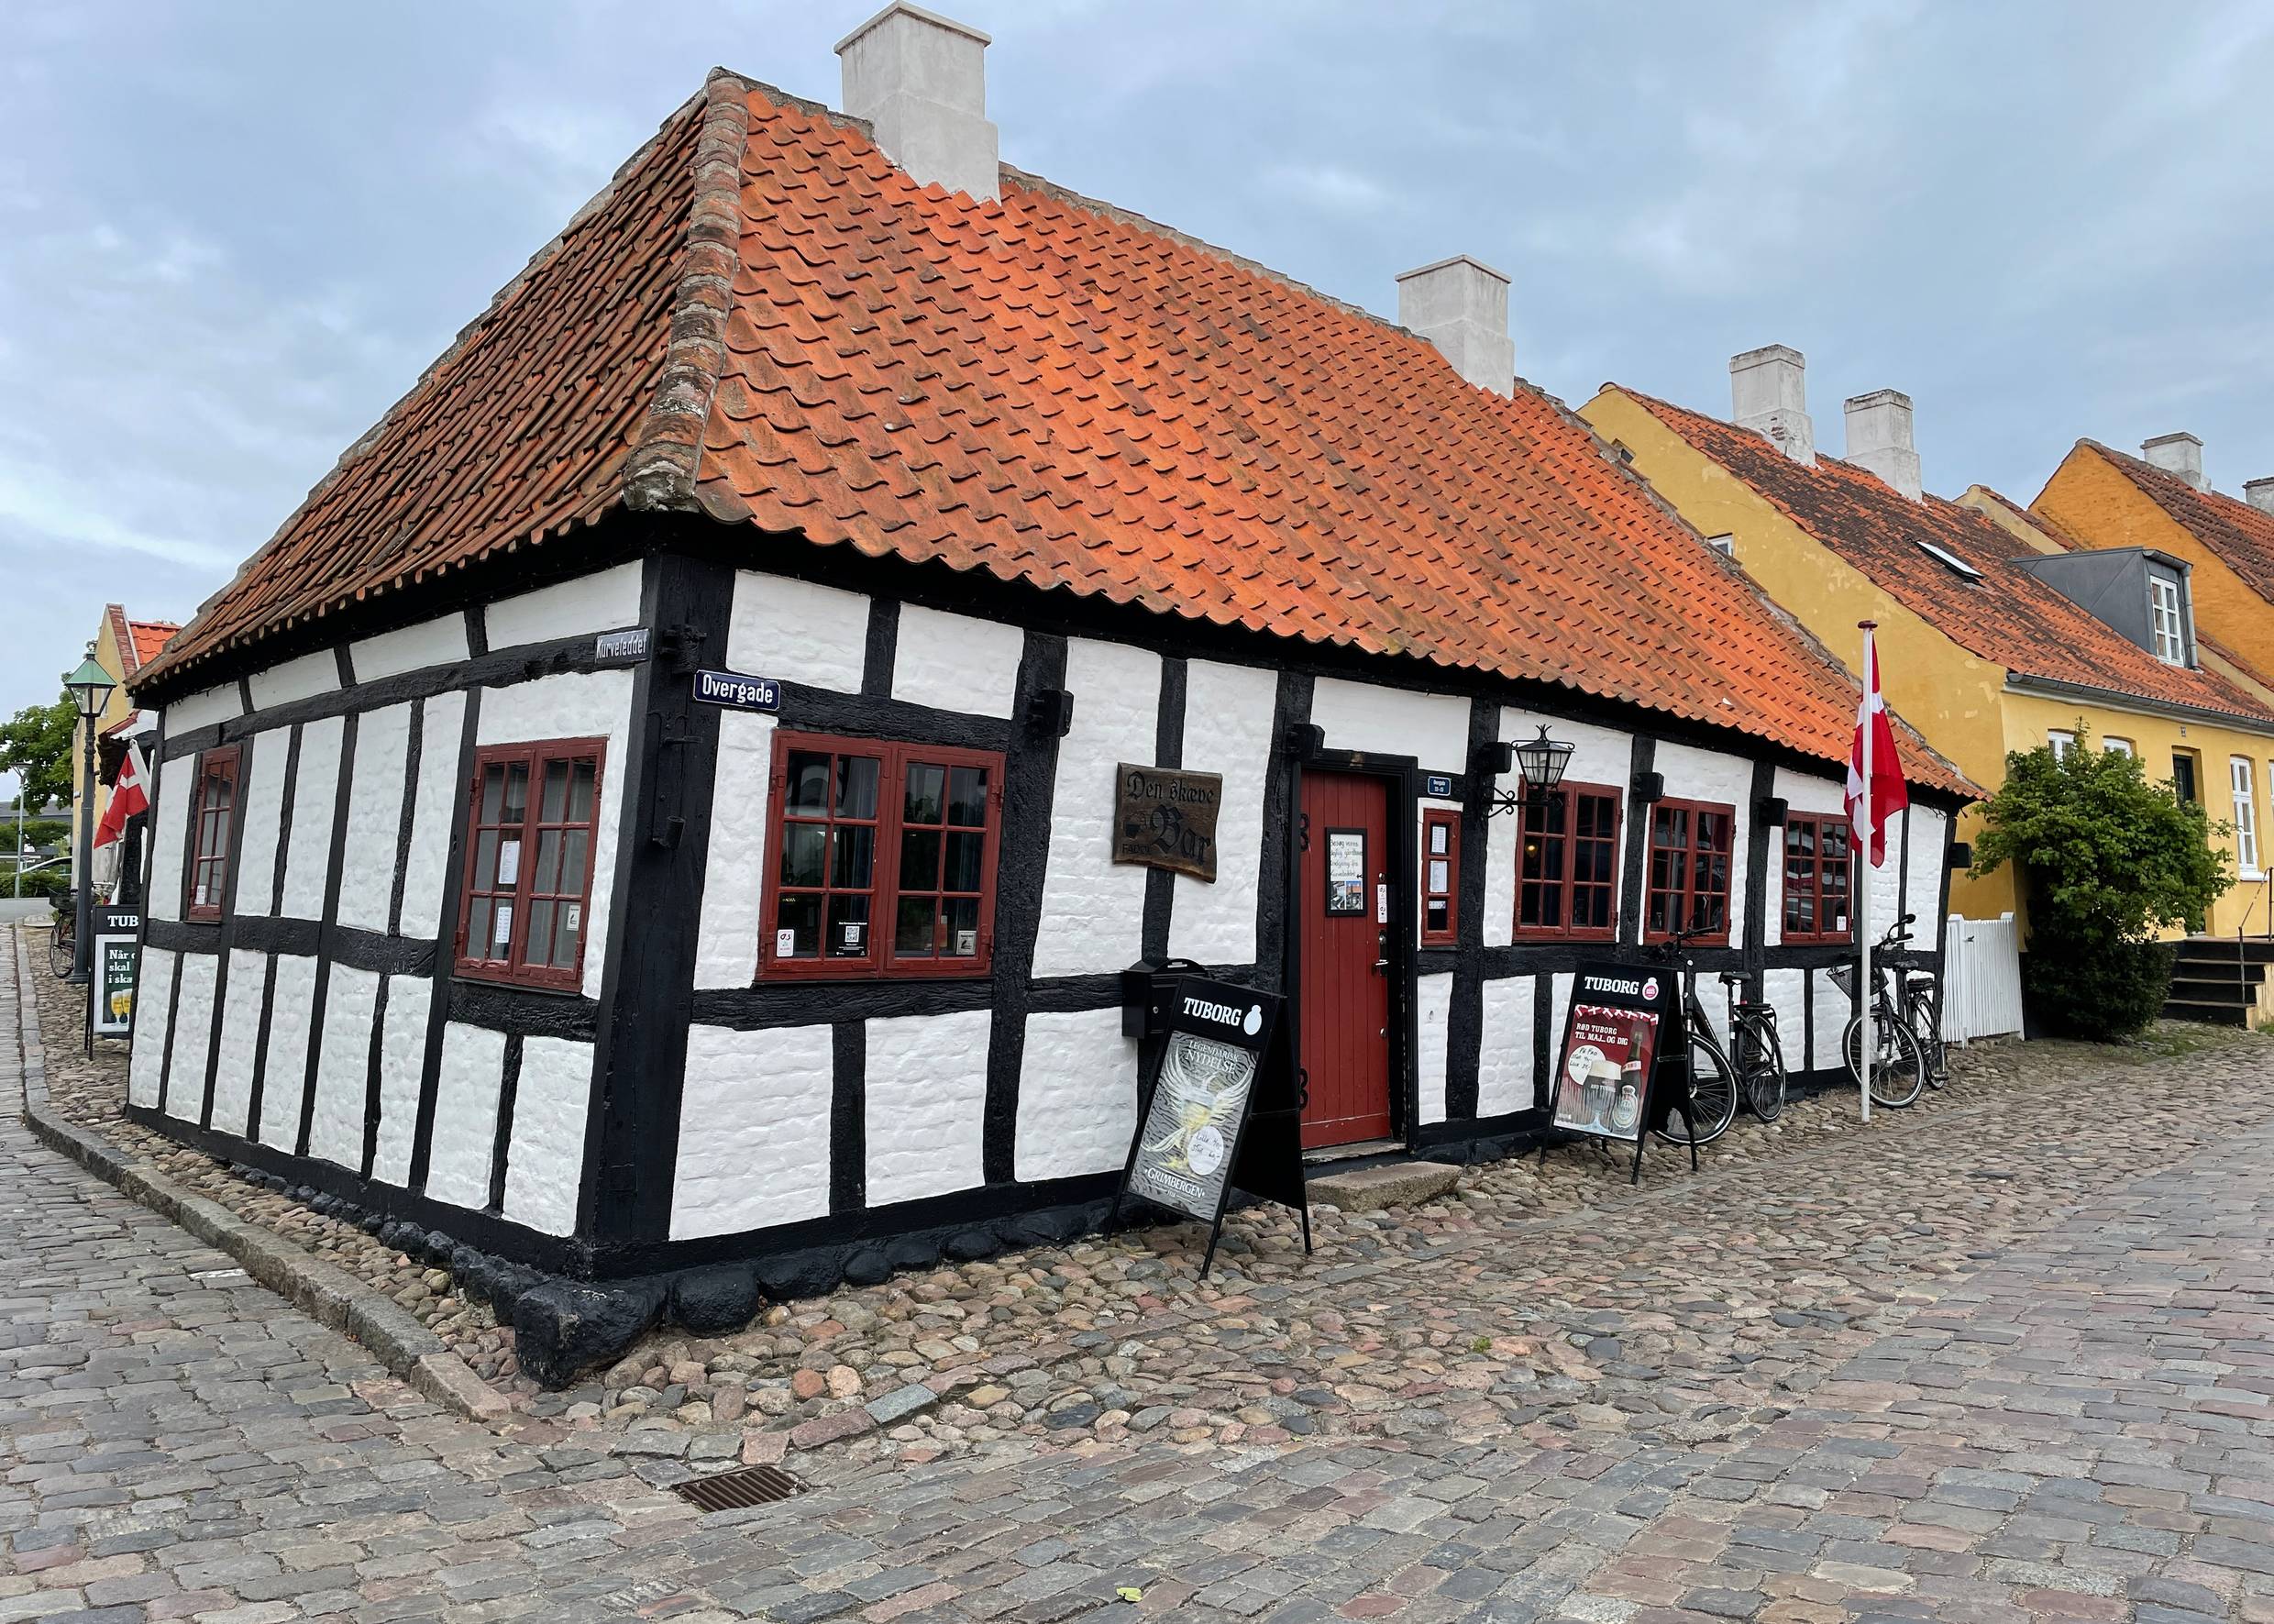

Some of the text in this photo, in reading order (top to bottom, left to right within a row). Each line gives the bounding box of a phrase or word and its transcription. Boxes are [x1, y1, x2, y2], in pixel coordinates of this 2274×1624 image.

[597, 634, 647, 659] Kurveleddet
[702, 674, 773, 703] Overgade
[1127, 771, 1163, 800] Den
[1150, 804, 1211, 866] Bar
[107, 915, 138, 927] TUB
[109, 950, 129, 960] Når
[108, 961, 130, 972] skal
[108, 974, 113, 984] i
[1584, 977, 1639, 995] TUBORG
[1183, 997, 1242, 1026] TUBORG
[1576, 1023, 1617, 1035] RØD TUBORG
[1188, 1041, 1240, 1062] LEGENDARISK
[1617, 1037, 1628, 1045] DIG
[1185, 1049, 1236, 1074] NYDELSE
[1147, 1167, 1203, 1198] GRIMBERGEN
